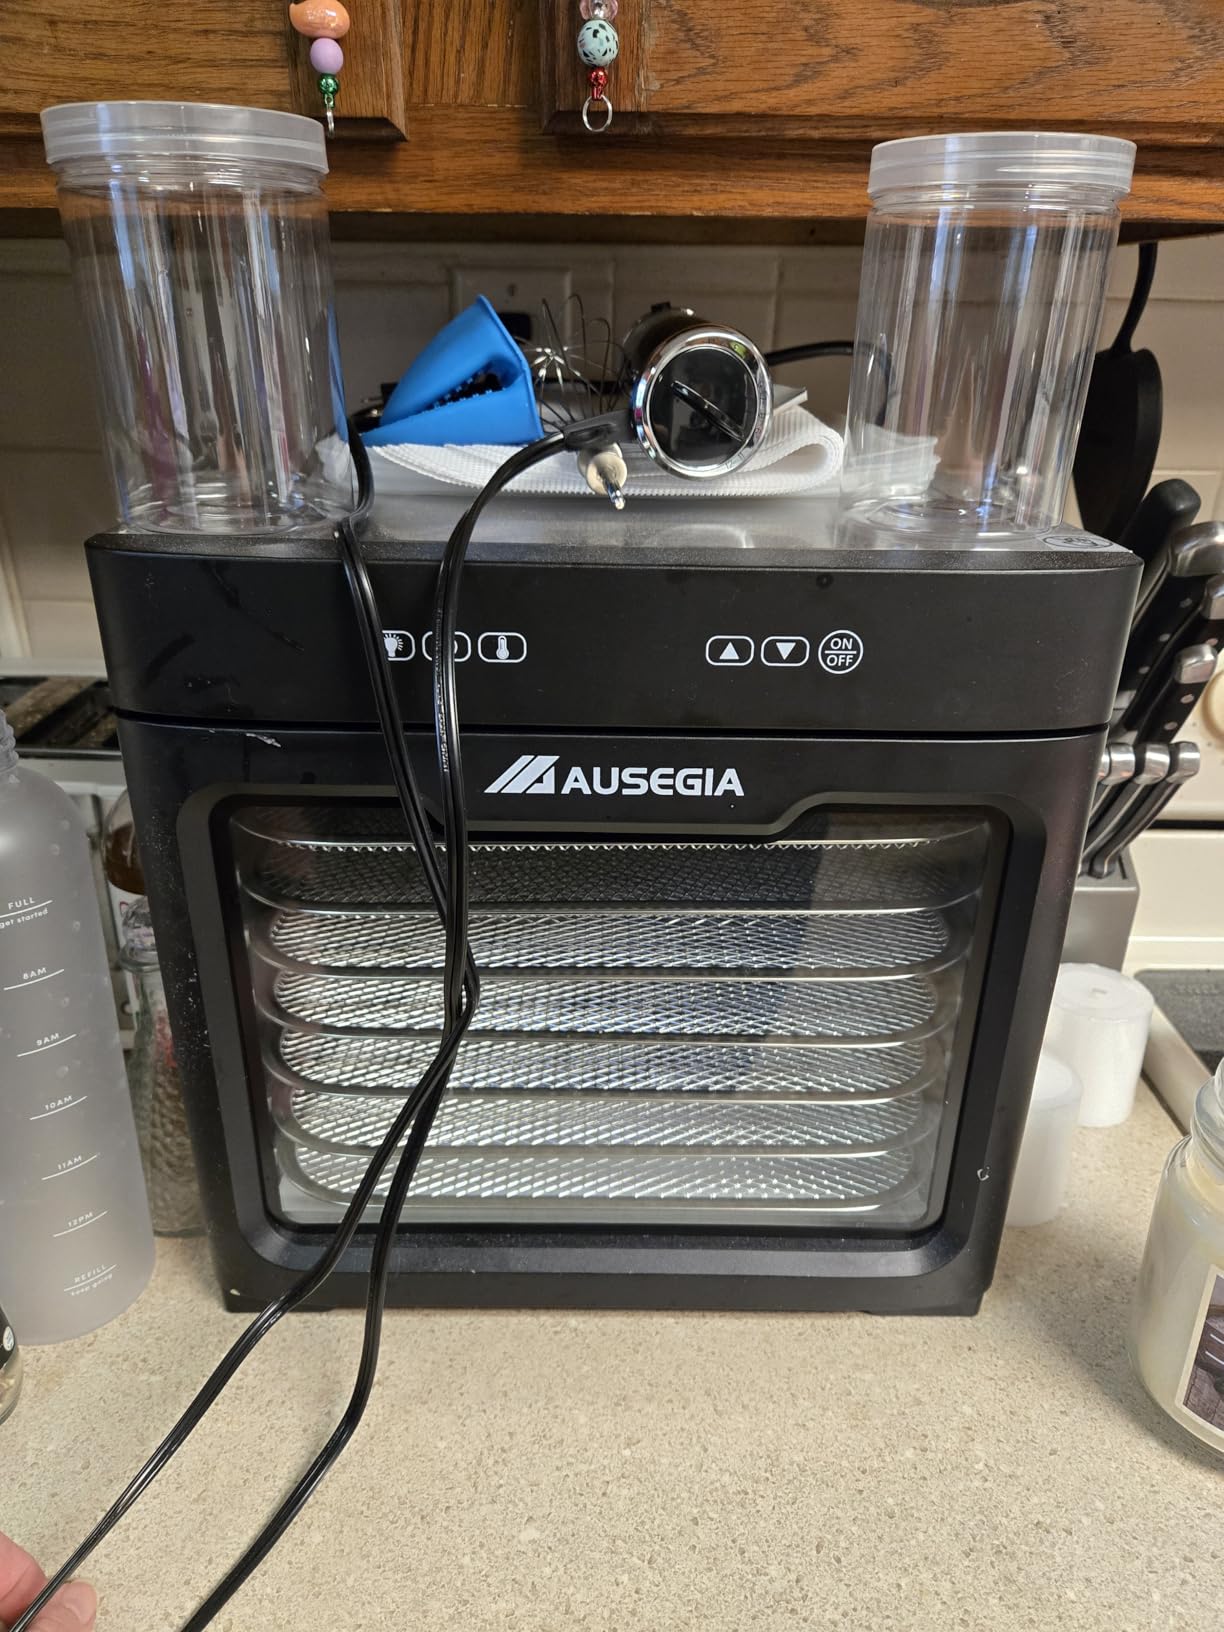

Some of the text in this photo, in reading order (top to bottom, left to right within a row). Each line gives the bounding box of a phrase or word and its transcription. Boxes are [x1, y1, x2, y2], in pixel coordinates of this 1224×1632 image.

[830, 637, 853, 650] ON
[826, 654, 854, 667] OFF
[561, 766, 745, 797] AUSEGIA
[8, 898, 36, 910] FULL
[17, 908, 48, 923] started
[23, 968, 47, 980] 8AM
[36, 1033, 60, 1046] 9AM
[45, 1095, 73, 1110] 10AM
[58, 1155, 83, 1170] 11AM
[68, 1212, 94, 1227] 12PM
[74, 1264, 107, 1283] REFILL
